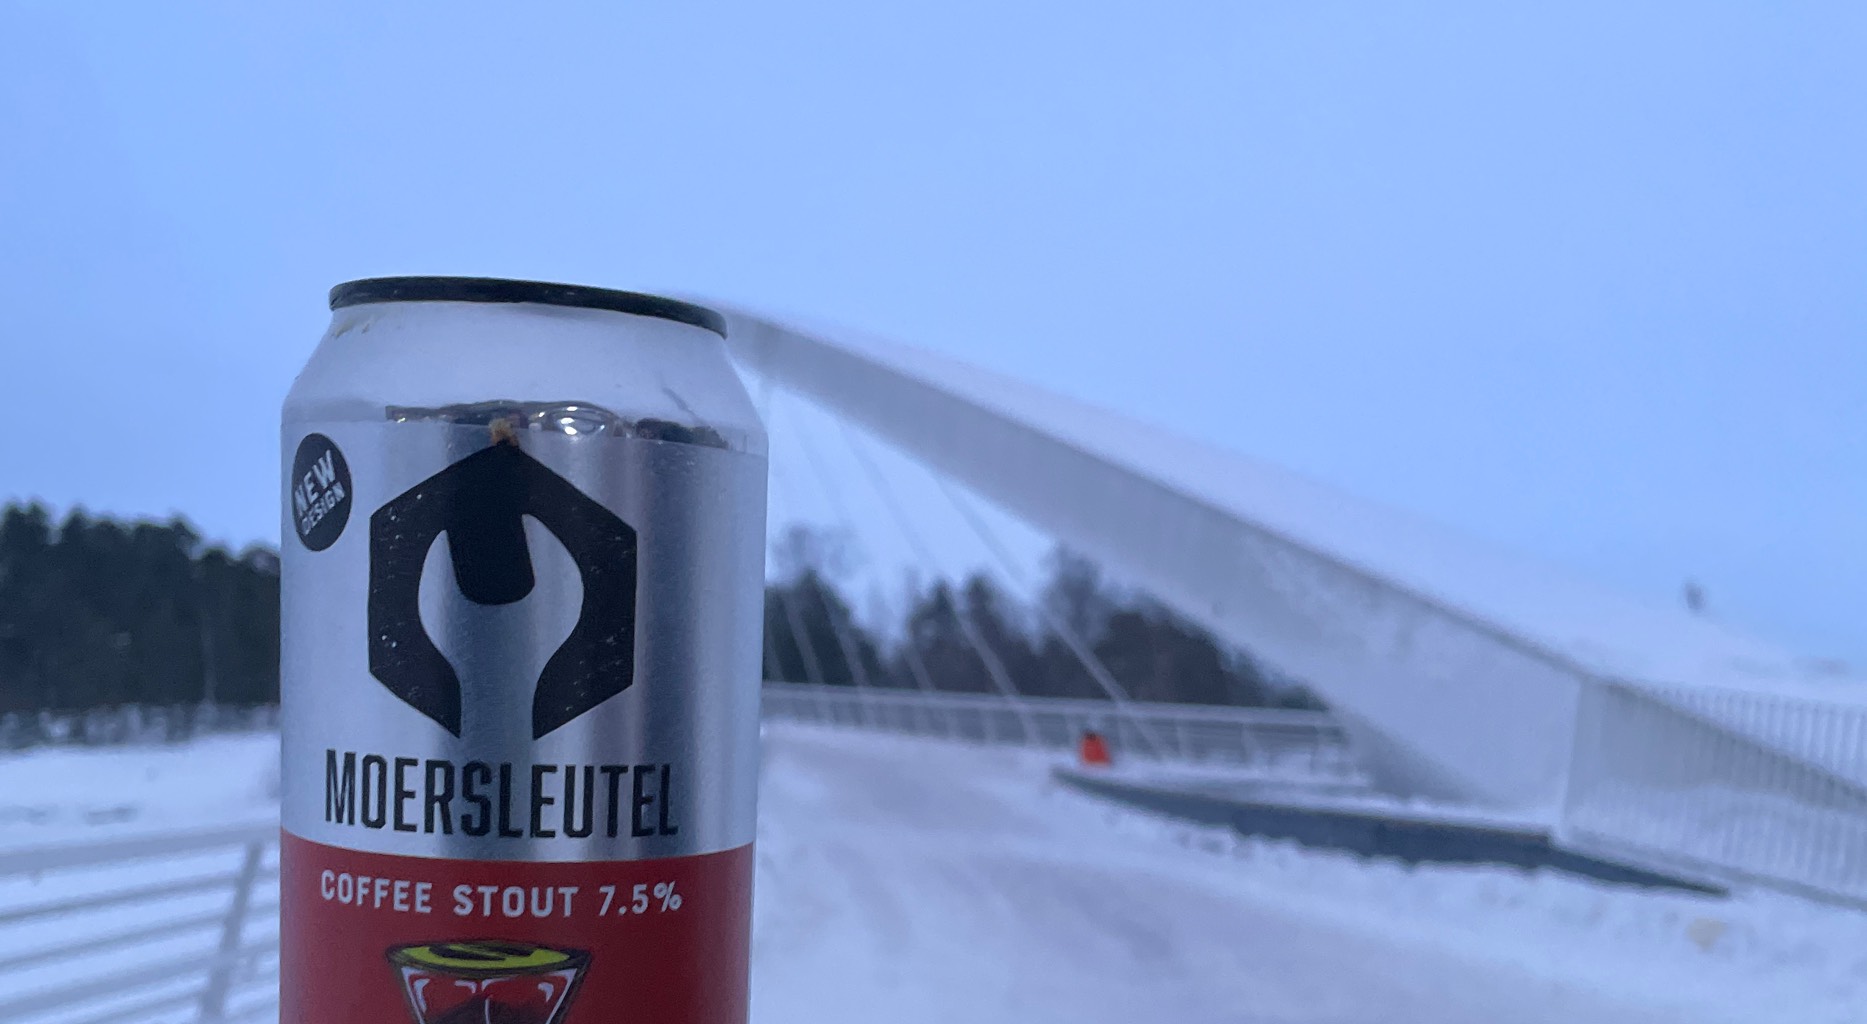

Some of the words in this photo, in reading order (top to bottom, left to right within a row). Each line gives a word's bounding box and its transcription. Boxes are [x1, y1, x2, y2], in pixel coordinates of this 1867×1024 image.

[295, 449, 336, 517] NEW
[302, 482, 345, 536] DESIGN
[325, 749, 680, 839] MOERSLEUTEL
[321, 869, 433, 913] COFFEE
[453, 884, 578, 917] STOUT
[599, 880, 683, 917] 7.5%
